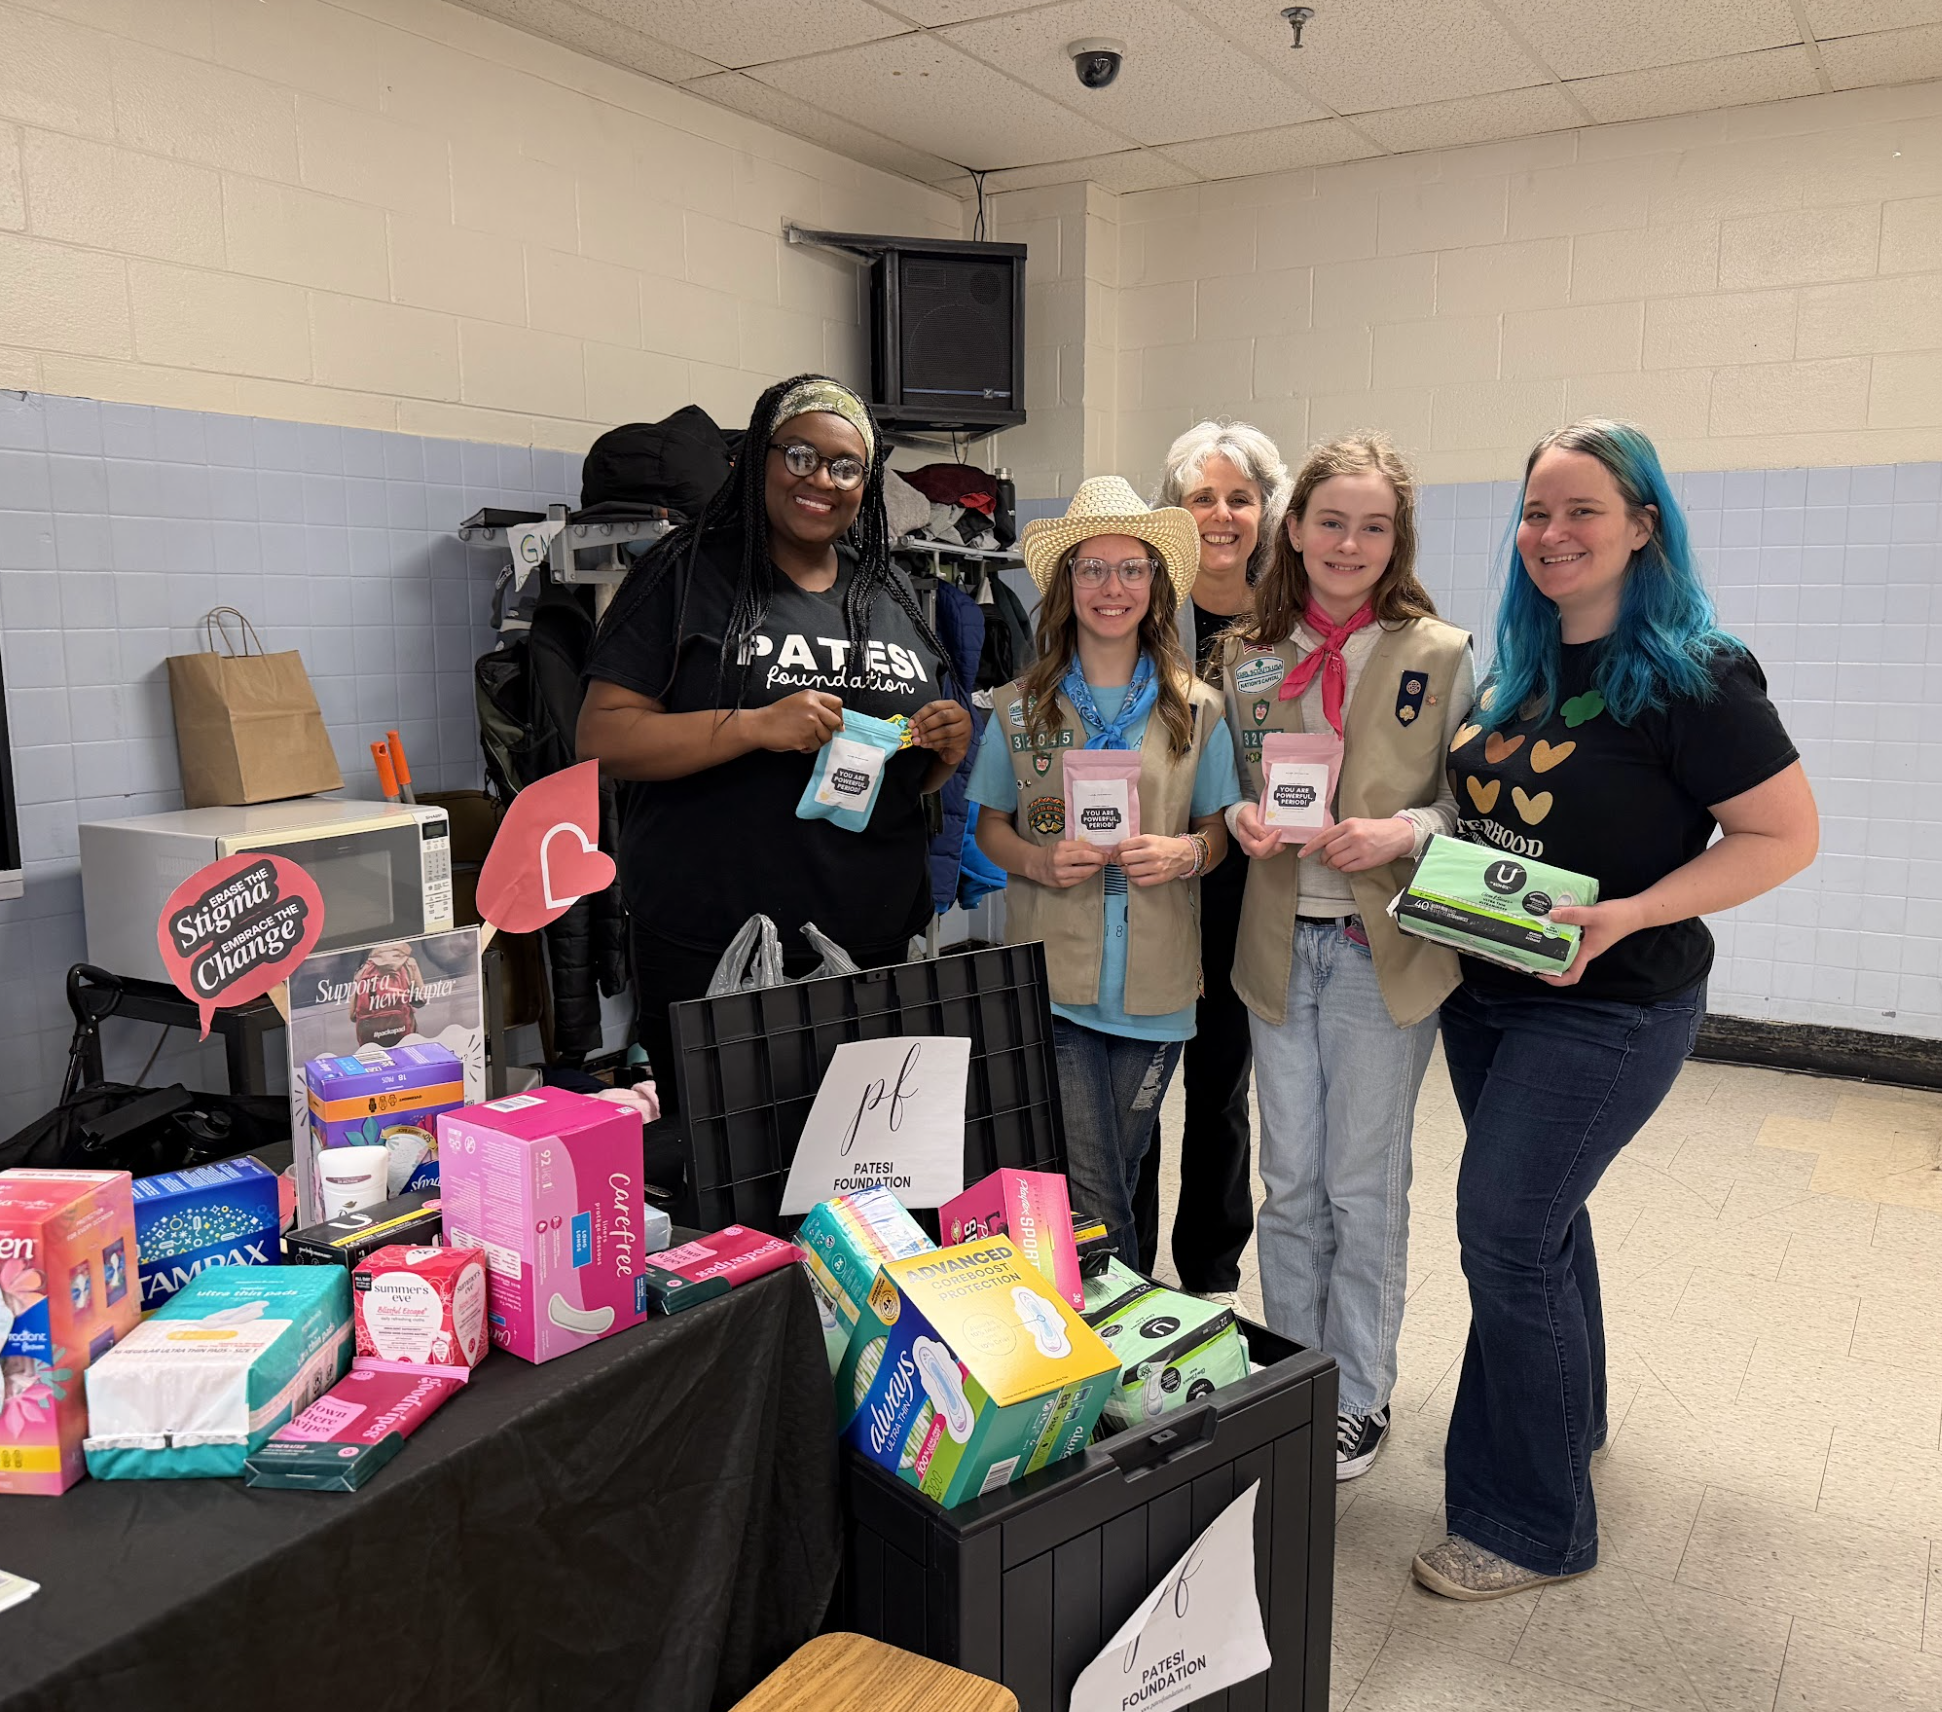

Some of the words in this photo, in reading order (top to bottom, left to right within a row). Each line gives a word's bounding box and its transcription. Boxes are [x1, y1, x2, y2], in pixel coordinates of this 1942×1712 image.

[737, 634, 928, 682] PATESI
[766, 666, 915, 694] foundation
[840, 770, 853, 779] YOU
[854, 774, 865, 782] ARE
[209, 880, 246, 908] ERASE
[244, 868, 269, 887] THE
[176, 879, 272, 949] Stigma
[1415, 900, 1429, 910] 40
[221, 915, 275, 953] EMBRACE
[274, 903, 299, 922] THE
[197, 919, 296, 991] Change
[315, 975, 379, 1006] Support
[380, 975, 390, 992] a
[369, 991, 401, 1011] new
[401, 979, 456, 1005] chapter
[541, 1149, 552, 1167] 92
[853, 1161, 893, 1175] PATESI
[833, 1176, 911, 1190] FOUNDATION
[1016, 1176, 1030, 1215] Playtex
[608, 1172, 637, 1278] Carefree
[695, 1239, 784, 1279] goodwipes
[1020, 1217, 1041, 1273] SPORT
[906, 1246, 1014, 1284] ADVANCED
[931, 1263, 1010, 1290] COREBOOST
[263, 1289, 298, 1298] pads
[374, 1284, 429, 1295] summer's
[392, 1294, 411, 1302] eve
[938, 1273, 1022, 1301] PROTECTION
[309, 1401, 347, 1419] own
[363, 1377, 442, 1439] goodwipes
[870, 1350, 915, 1454] always
[292, 1419, 334, 1433] wipes
[885, 1423, 902, 1452] ULTRA
[899, 1399, 911, 1423] THIN
[1122, 1655, 1207, 1711] FOUNDATION
[1142, 1649, 1185, 1684] PATESI
